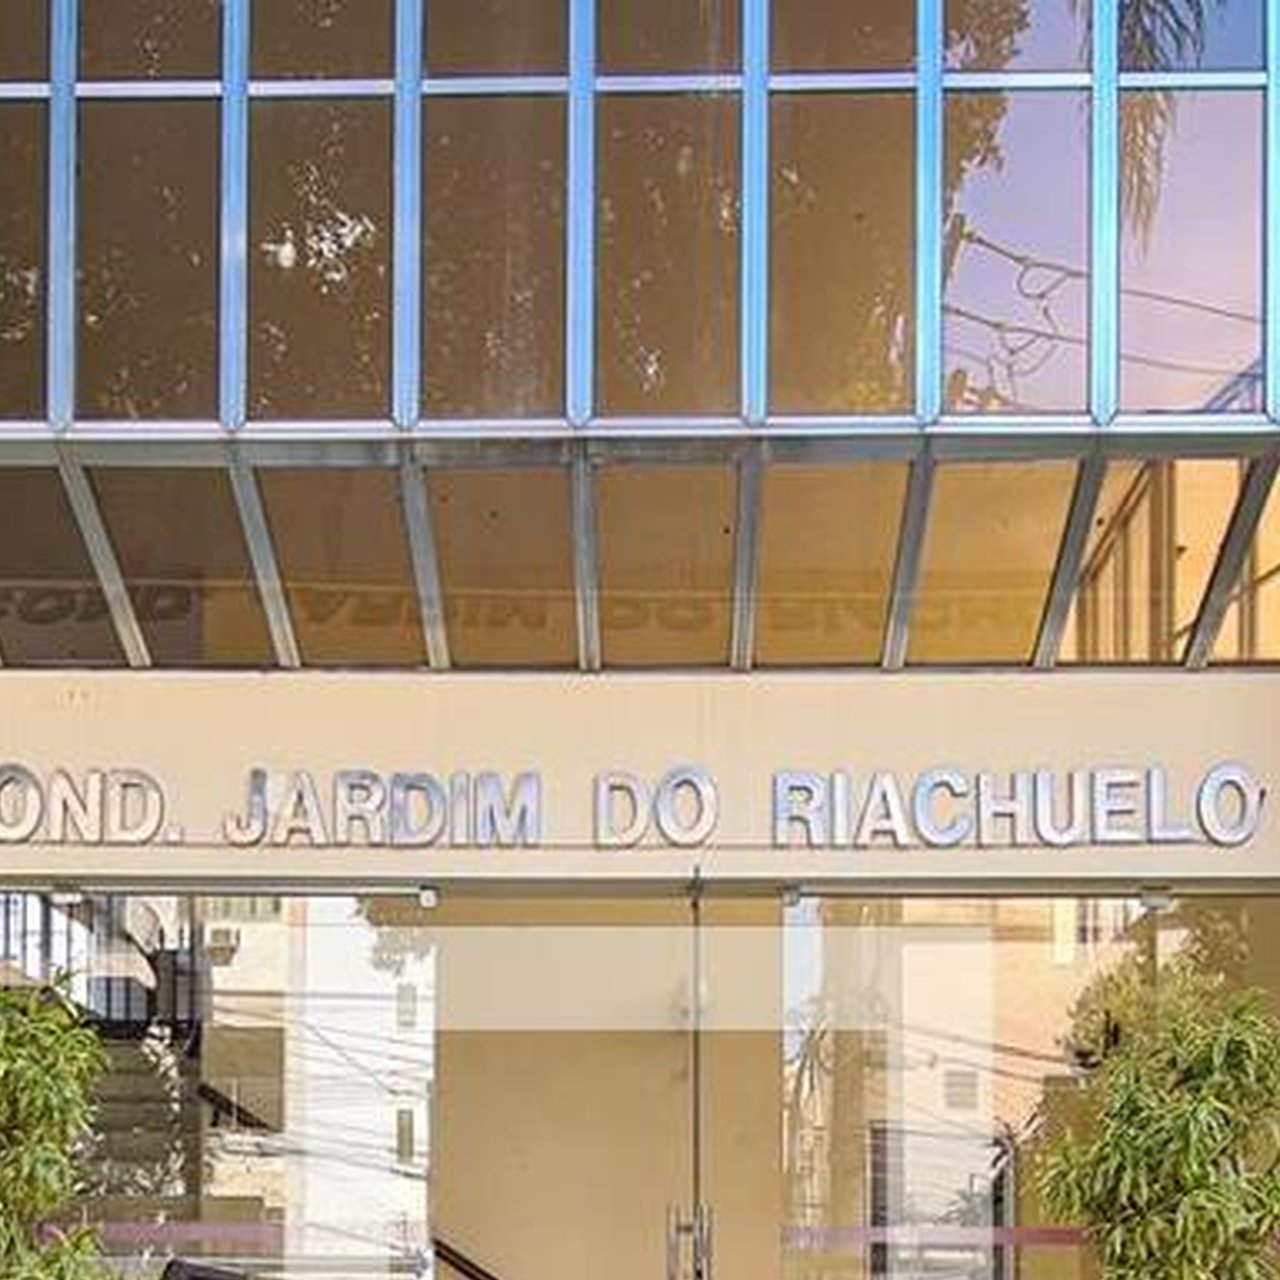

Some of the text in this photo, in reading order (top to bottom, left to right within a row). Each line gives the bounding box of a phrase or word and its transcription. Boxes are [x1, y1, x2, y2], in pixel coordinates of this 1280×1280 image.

[222, 768, 542, 847] JARDIM
[594, 766, 718, 847] DO
[773, 763, 1261, 847] RIACHUELO
